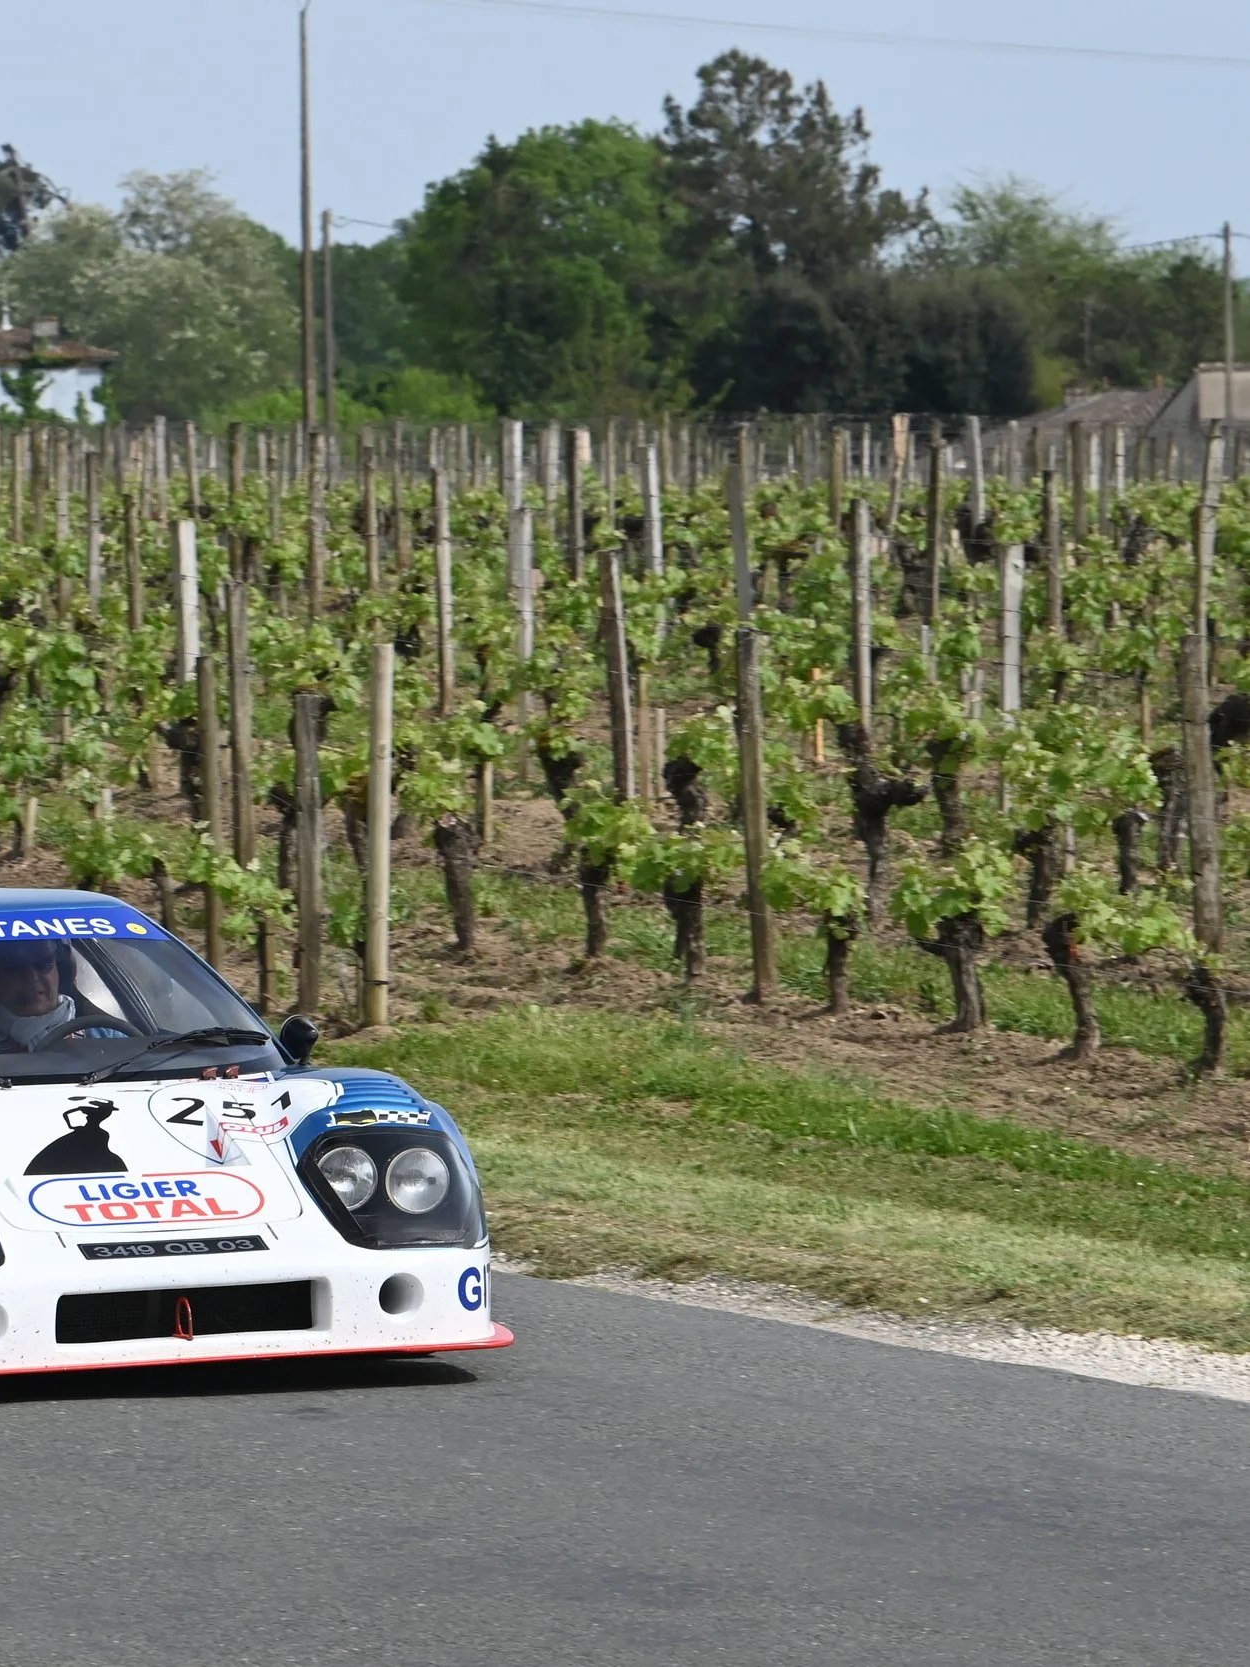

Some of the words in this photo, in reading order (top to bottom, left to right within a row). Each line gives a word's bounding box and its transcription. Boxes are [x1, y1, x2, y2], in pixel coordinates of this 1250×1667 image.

[78, 1180, 201, 1201] LIGIER
[64, 1198, 239, 1222] TOTAL
[94, 1244, 156, 1258] 3419
[165, 1241, 210, 1254] QB
[217, 1238, 255, 1251] 03
